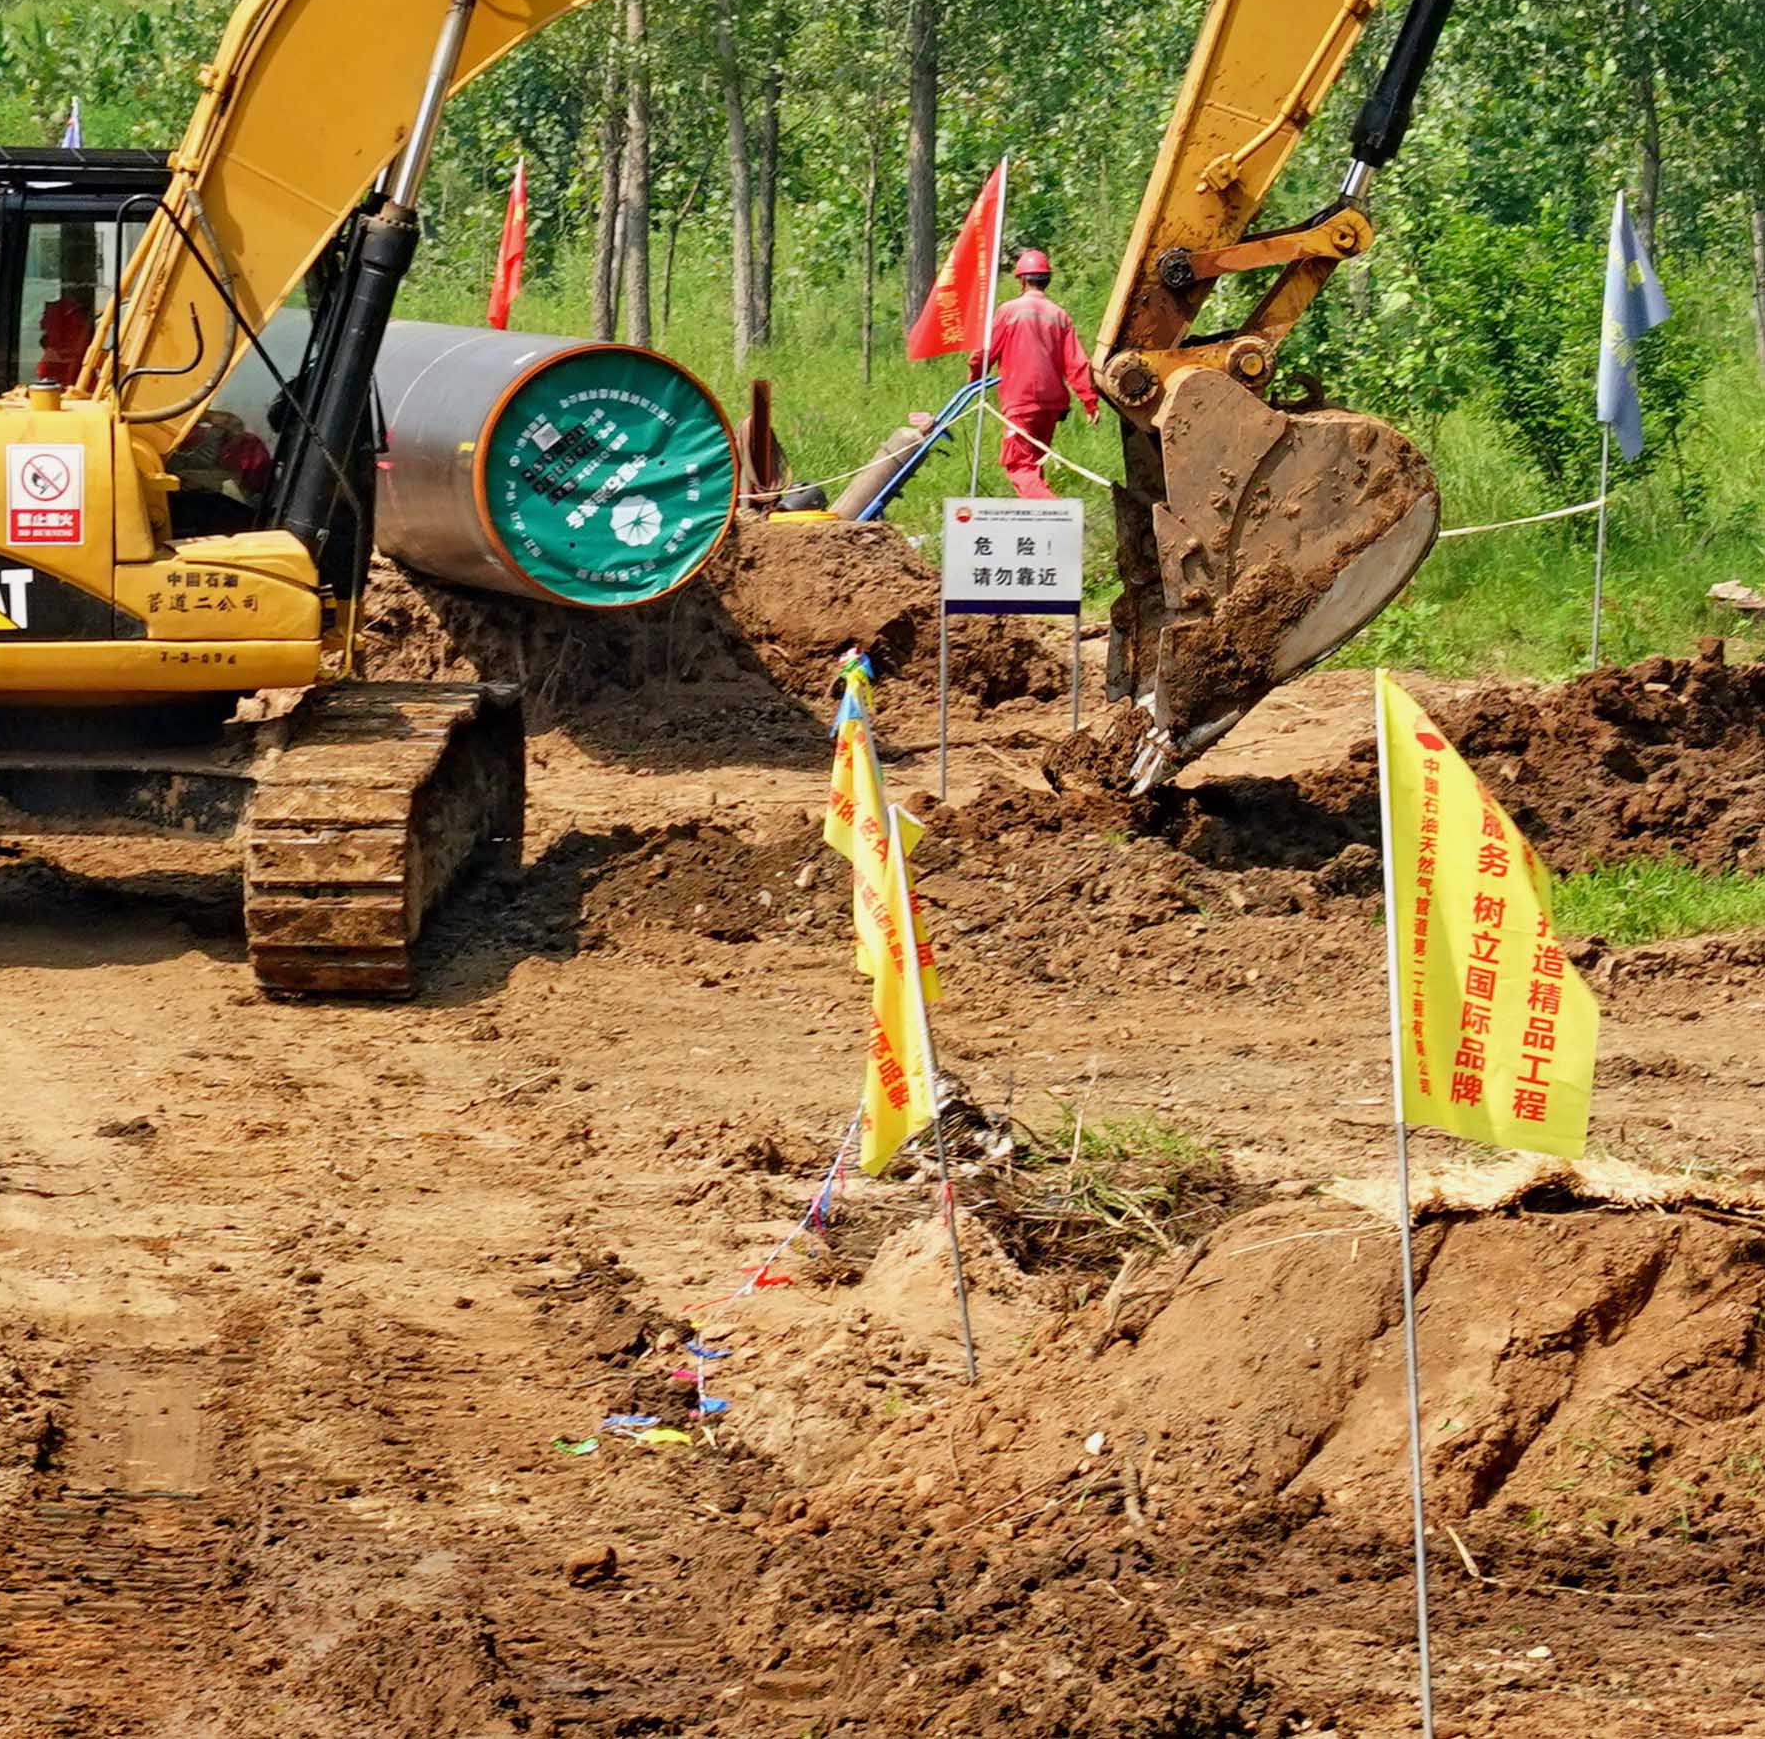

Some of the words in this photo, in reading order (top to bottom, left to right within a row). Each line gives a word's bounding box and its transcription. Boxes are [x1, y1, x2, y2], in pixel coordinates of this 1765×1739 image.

[166, 571, 239, 588] 中国石油
[973, 567, 1058, 587] 请勿靠近
[1449, 890, 1507, 1108] 树立国际品牌
